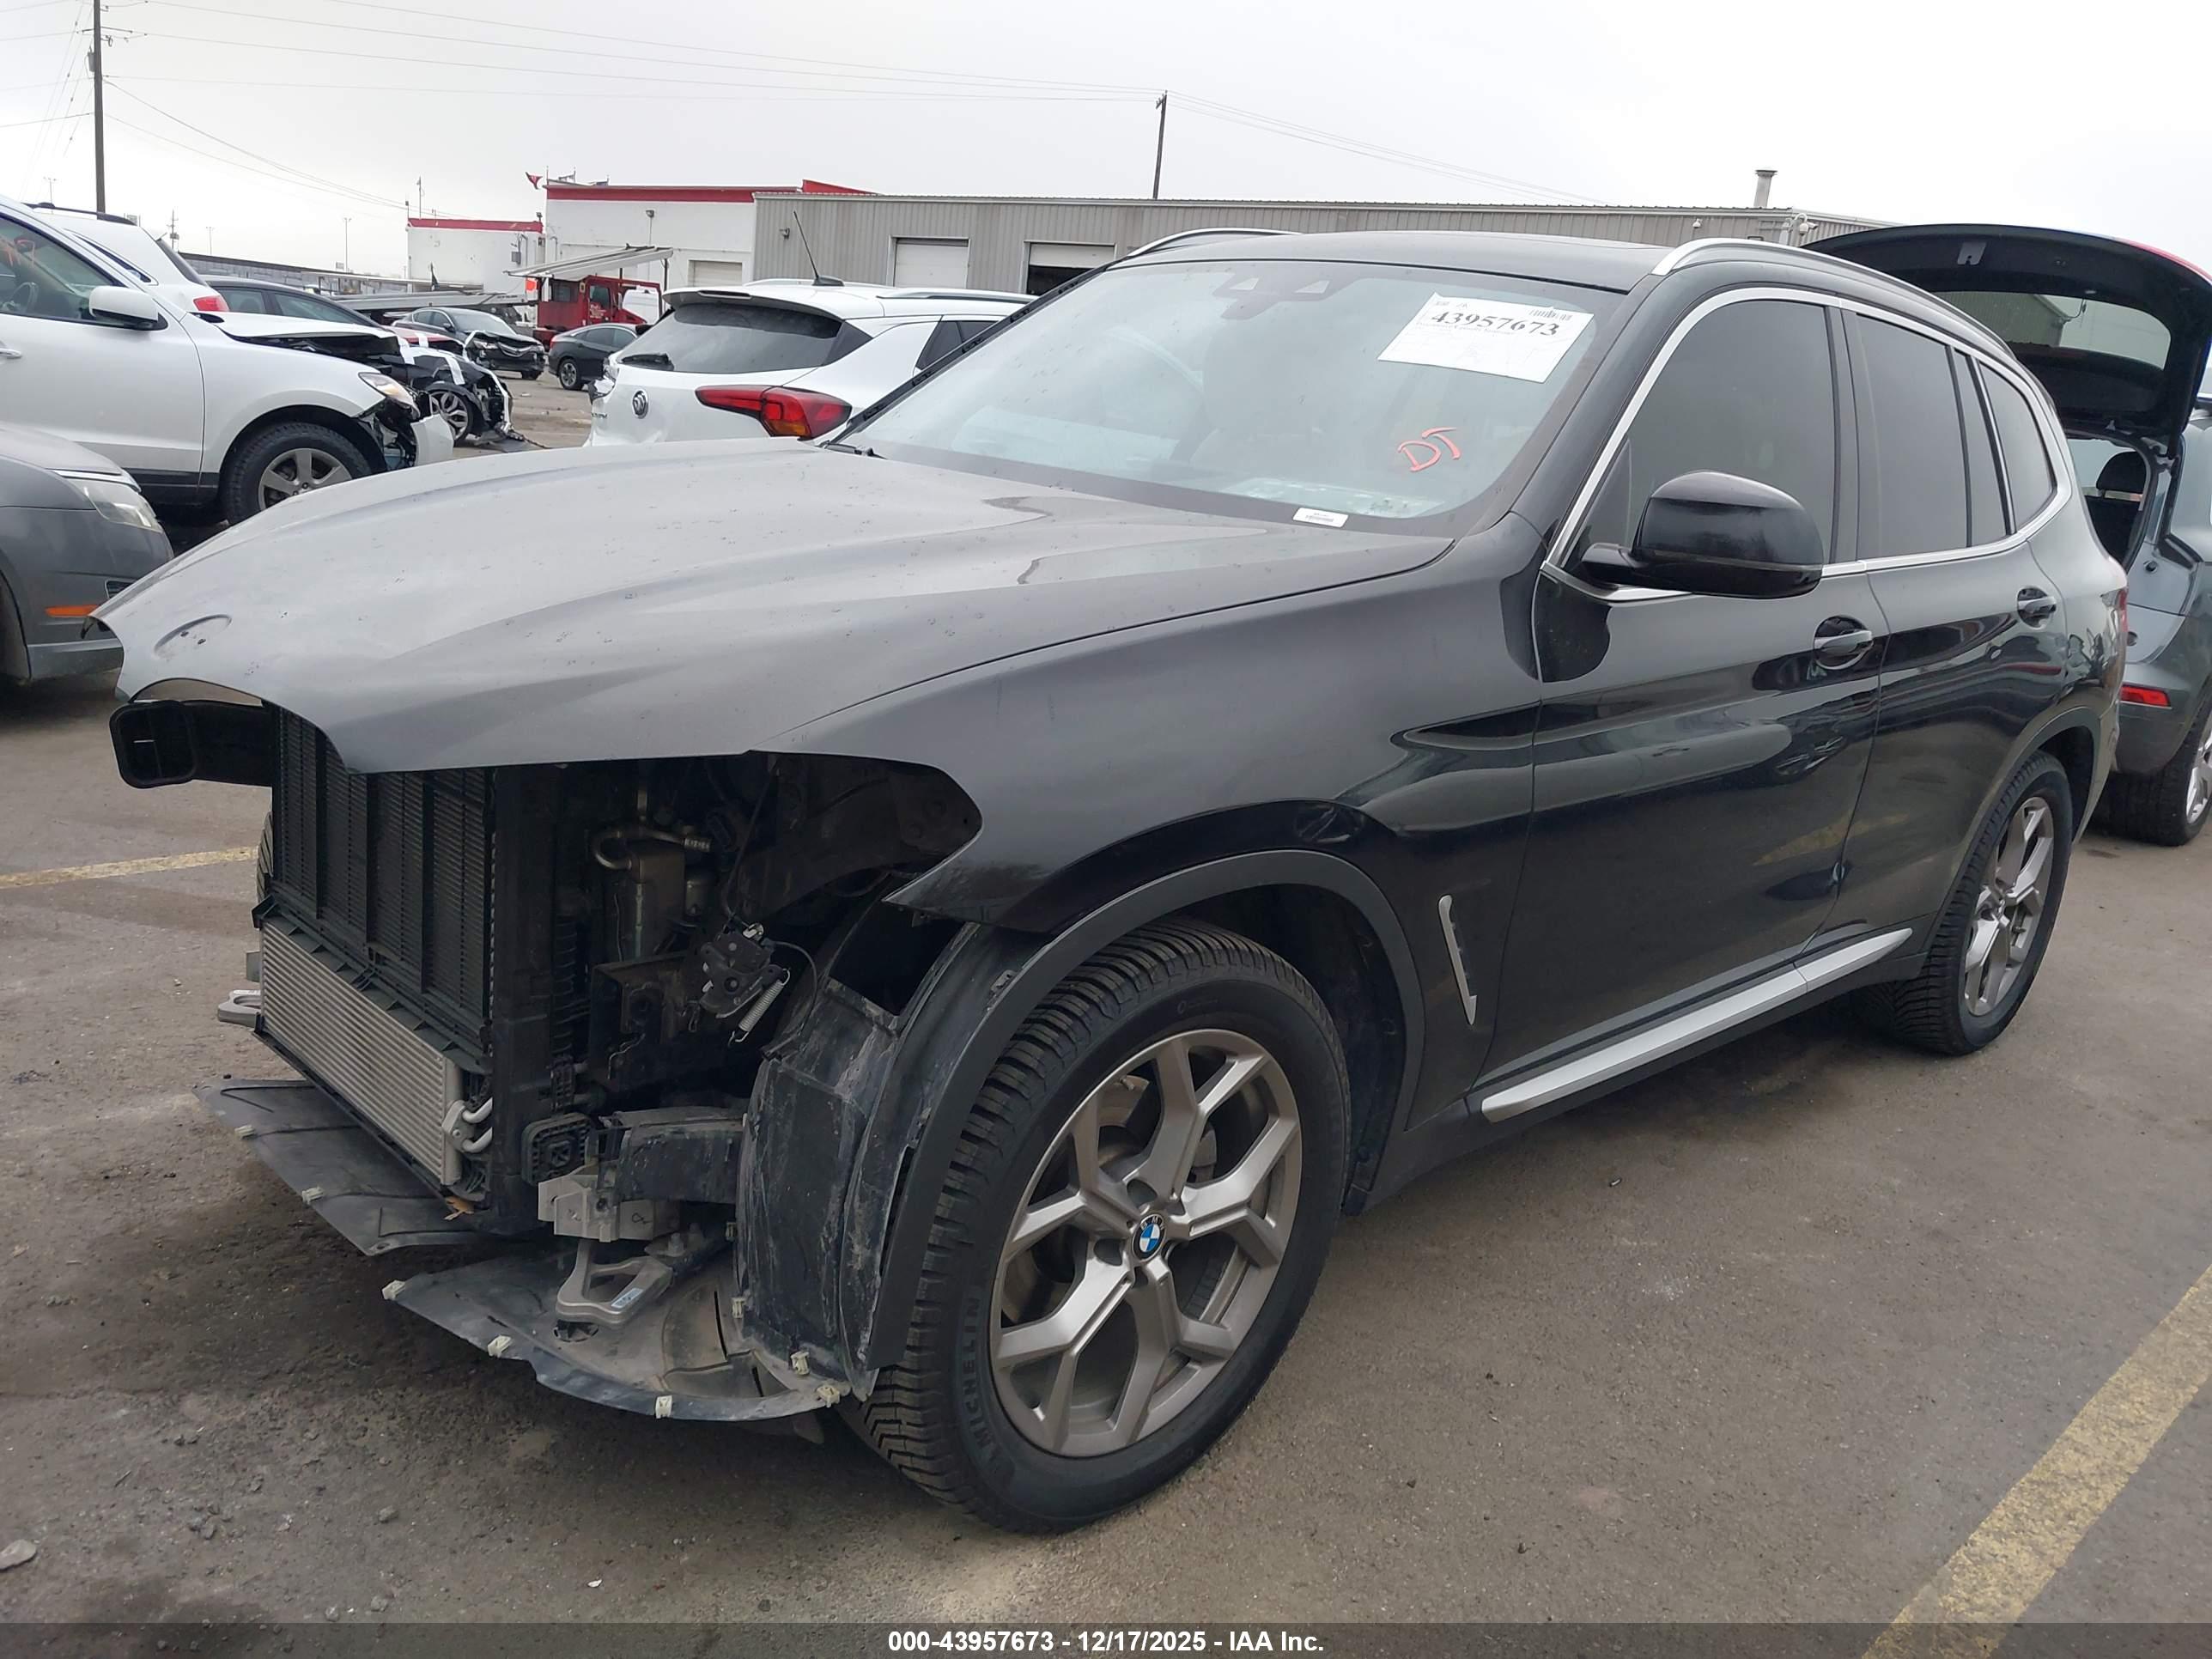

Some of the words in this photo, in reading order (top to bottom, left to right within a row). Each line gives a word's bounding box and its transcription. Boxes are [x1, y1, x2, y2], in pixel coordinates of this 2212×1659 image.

[1431, 310, 1559, 337] 43957673
[1139, 1215, 1164, 1231] BMW
[963, 1297, 993, 1448] MICHELIN
